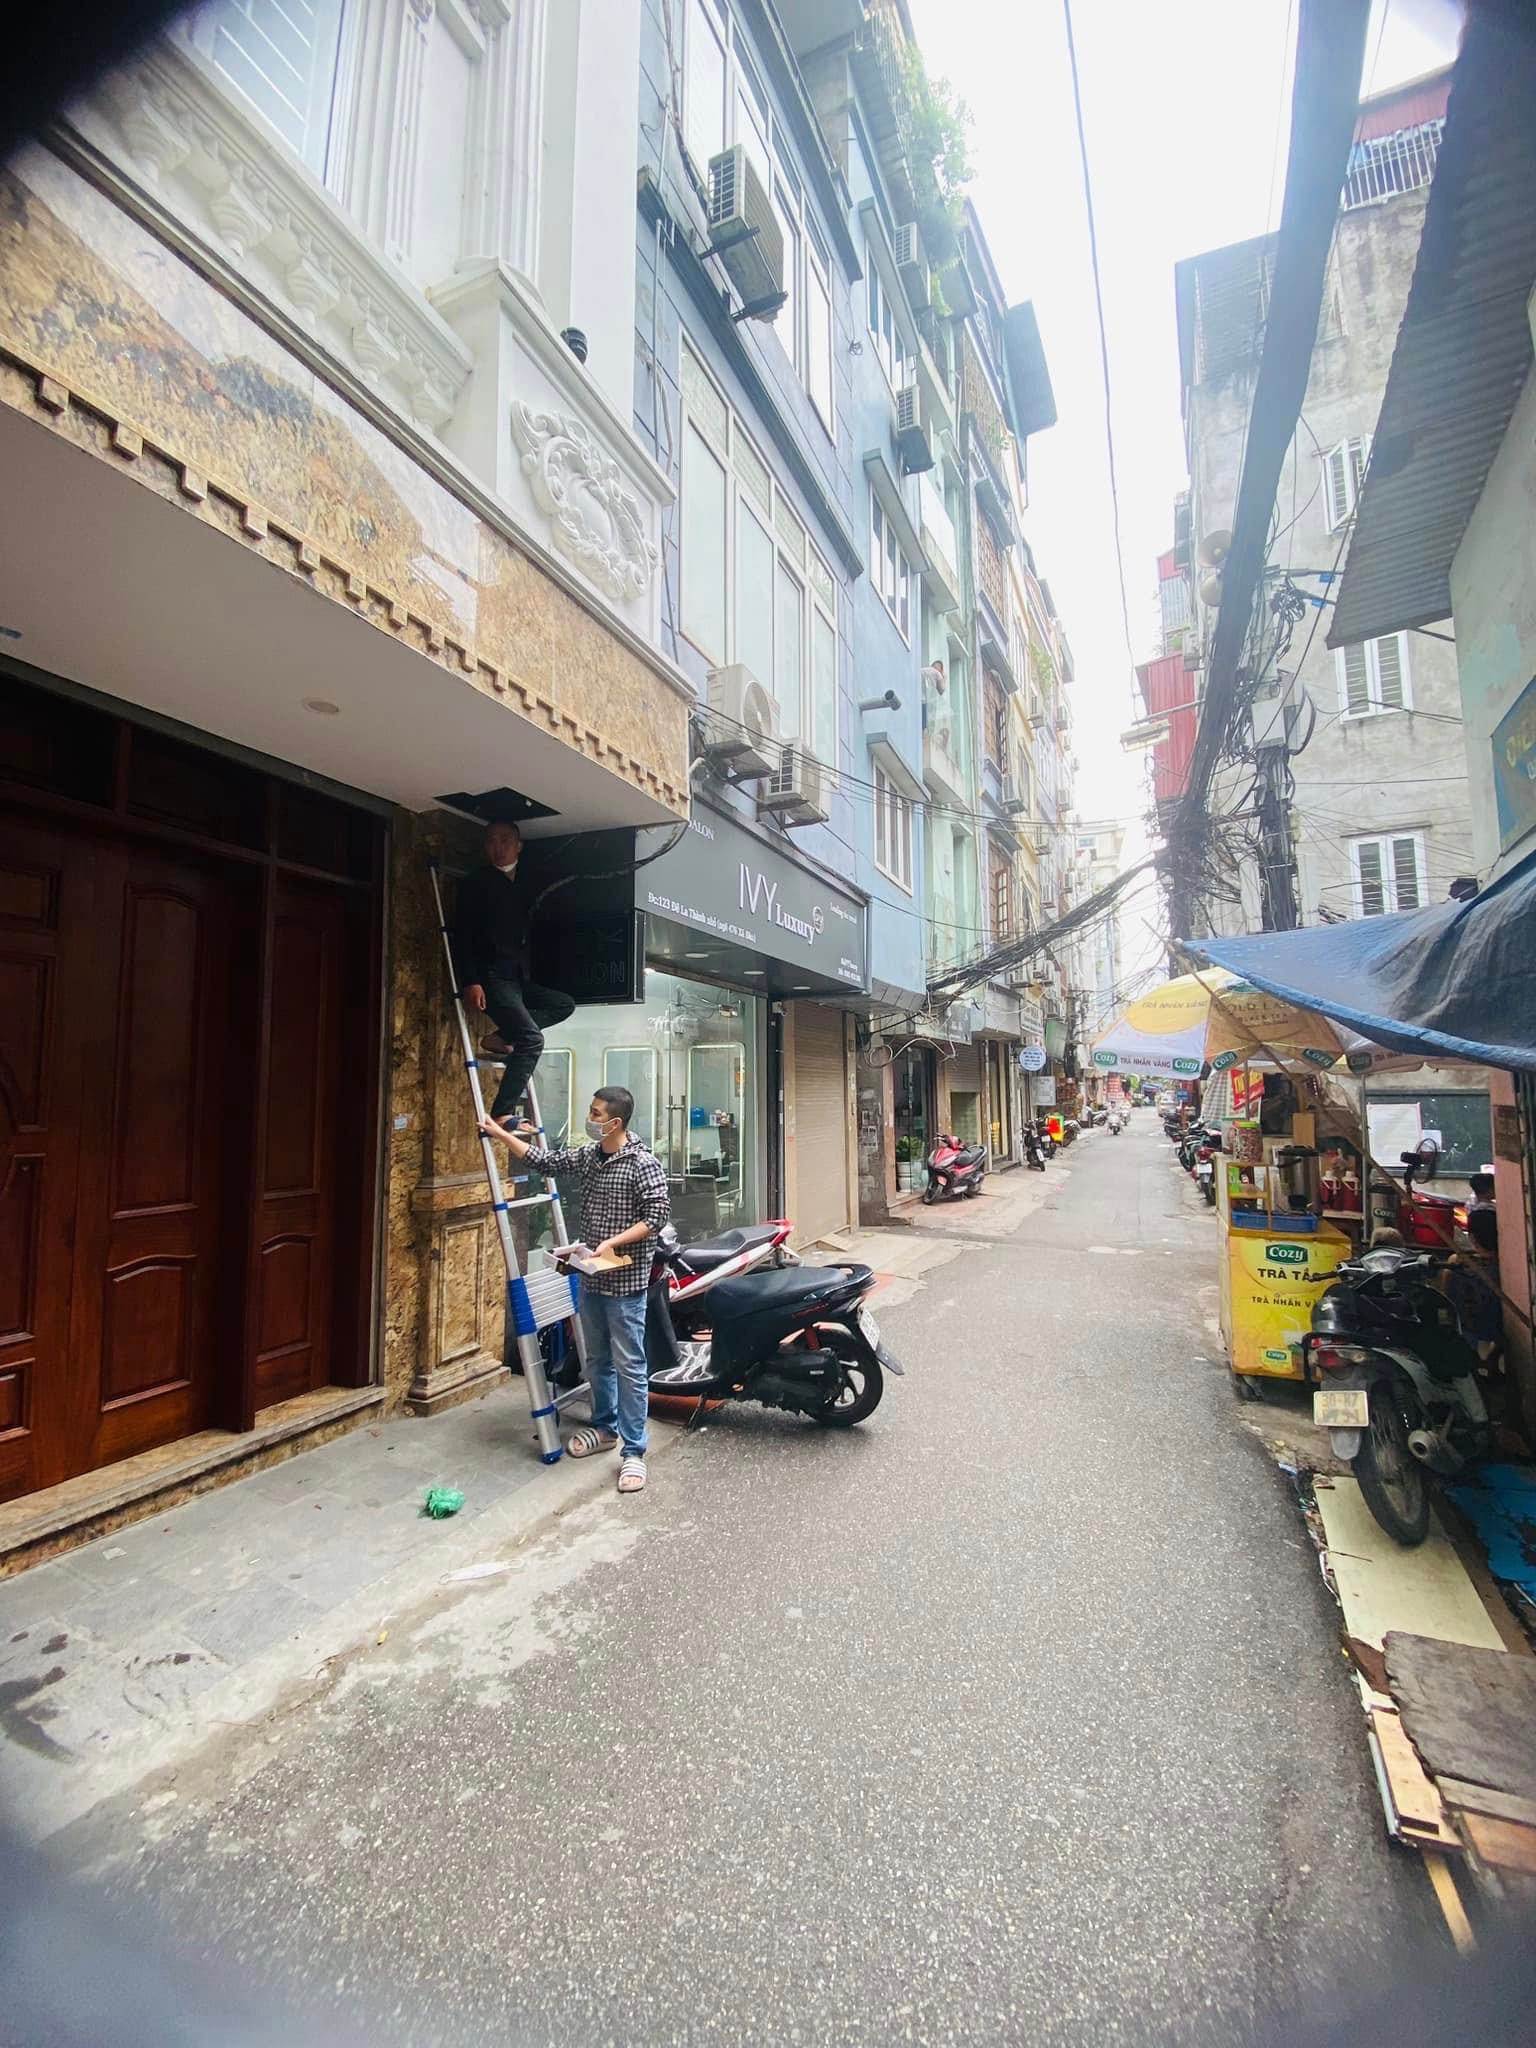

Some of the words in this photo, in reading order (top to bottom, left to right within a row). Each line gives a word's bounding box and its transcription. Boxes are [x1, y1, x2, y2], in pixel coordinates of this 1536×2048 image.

[739, 863, 778, 921] IVY
[776, 903, 815, 945] Luxury
[1095, 1052, 1115, 1064] Cozy
[1174, 1059, 1198, 1072] Cozy
[1214, 1052, 1235, 1068] Cozy
[1269, 1246, 1304, 1262] Cozy
[1257, 1267, 1287, 1279] TRÀ
[1252, 1296, 1269, 1304] TRÀ
[1273, 1296, 1301, 1307] NHÂN
